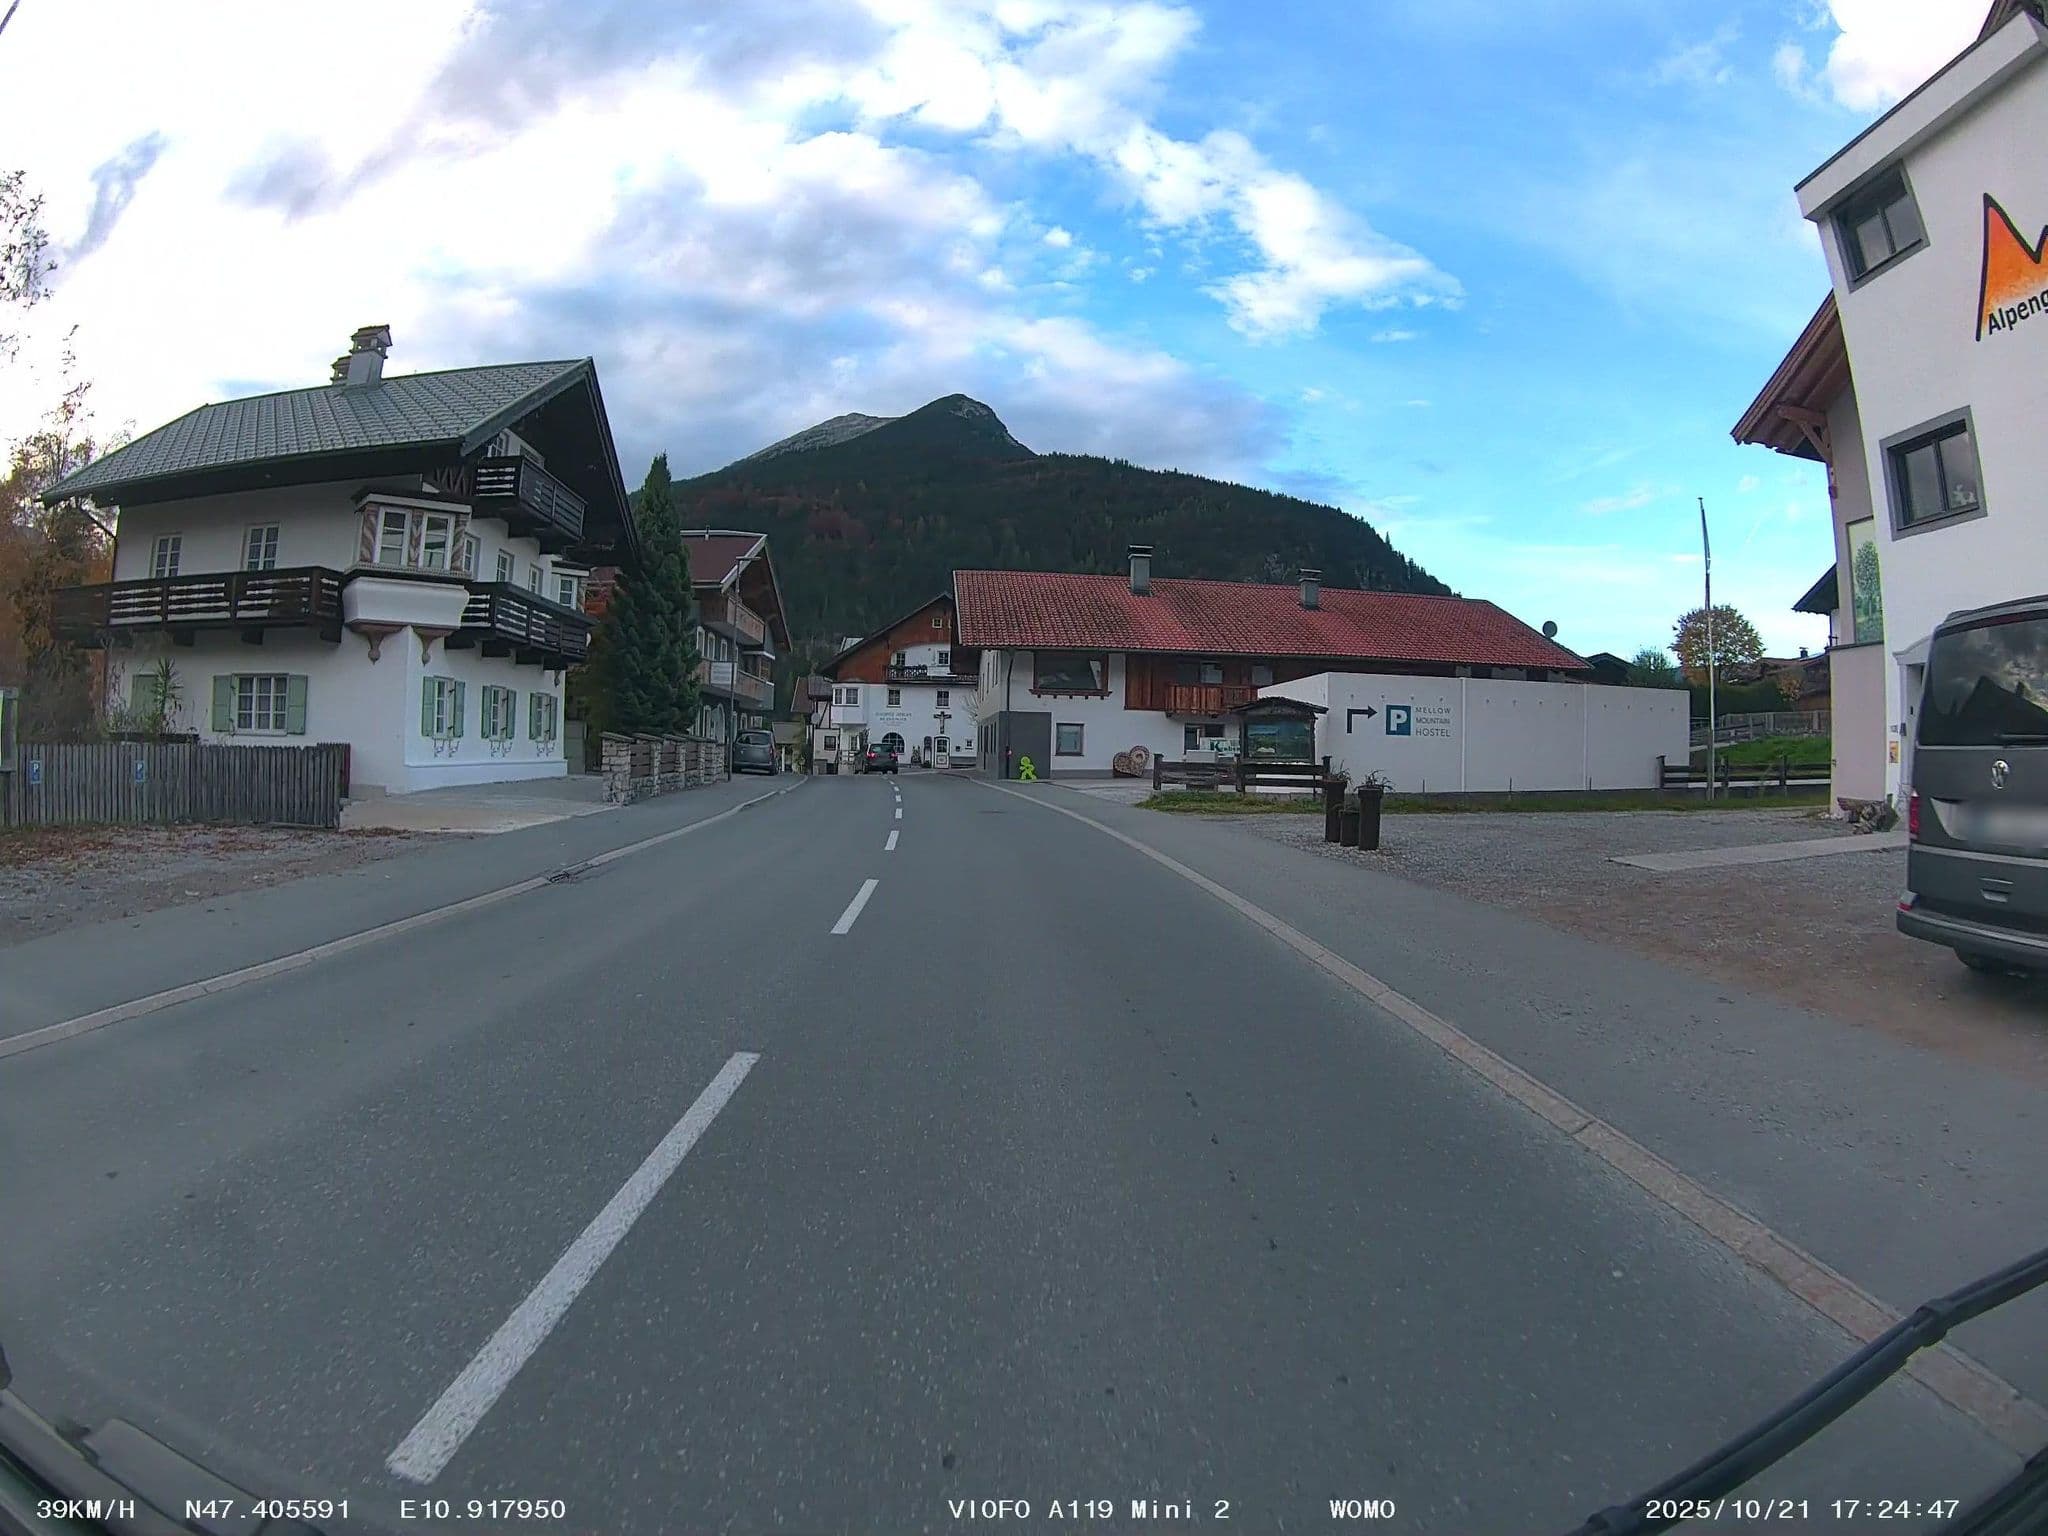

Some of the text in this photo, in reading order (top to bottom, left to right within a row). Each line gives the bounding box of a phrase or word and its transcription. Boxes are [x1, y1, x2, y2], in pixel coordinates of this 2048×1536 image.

[1415, 706, 1451, 714] MELLOW
[1390, 709, 1408, 731] P
[1415, 728, 1451, 737] HOSTEL
